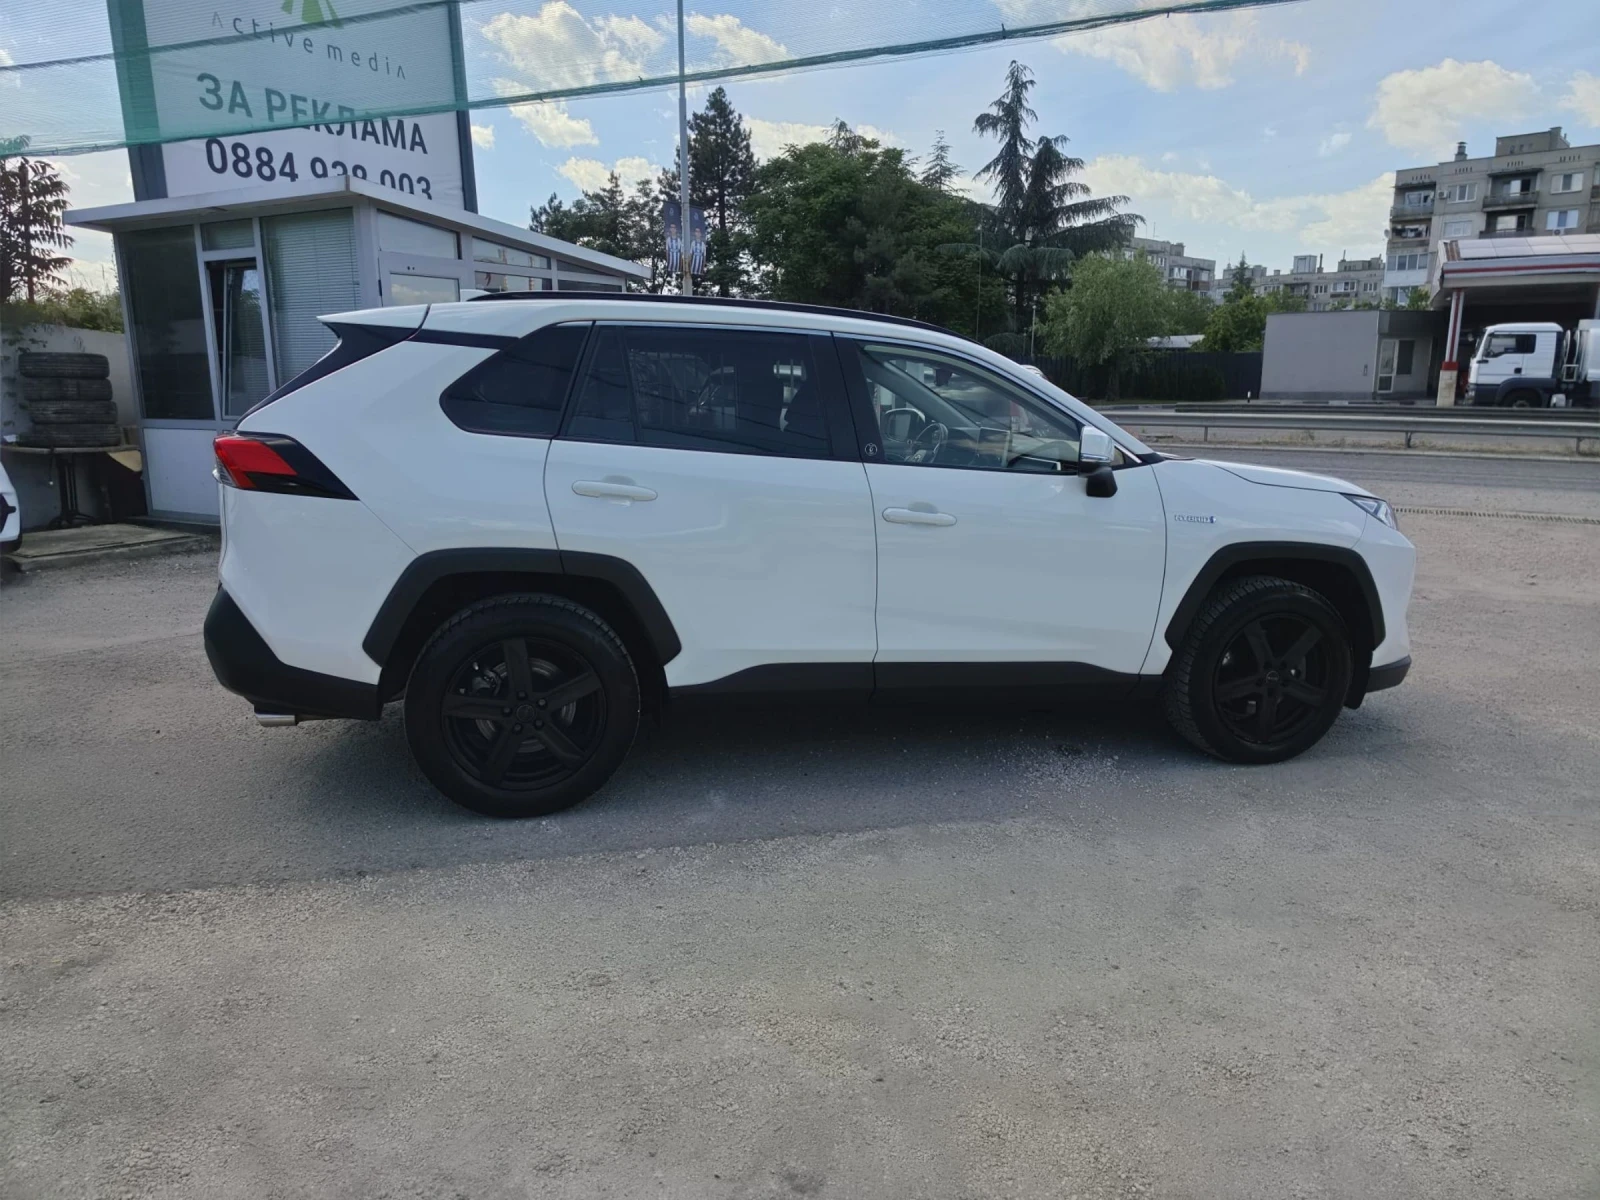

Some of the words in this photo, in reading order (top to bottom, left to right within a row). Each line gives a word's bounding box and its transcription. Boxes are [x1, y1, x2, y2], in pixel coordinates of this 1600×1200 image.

[196, 72, 253, 118] ЗА
[264, 87, 428, 154] РЕКЛАМА
[205, 137, 299, 182] 0884
